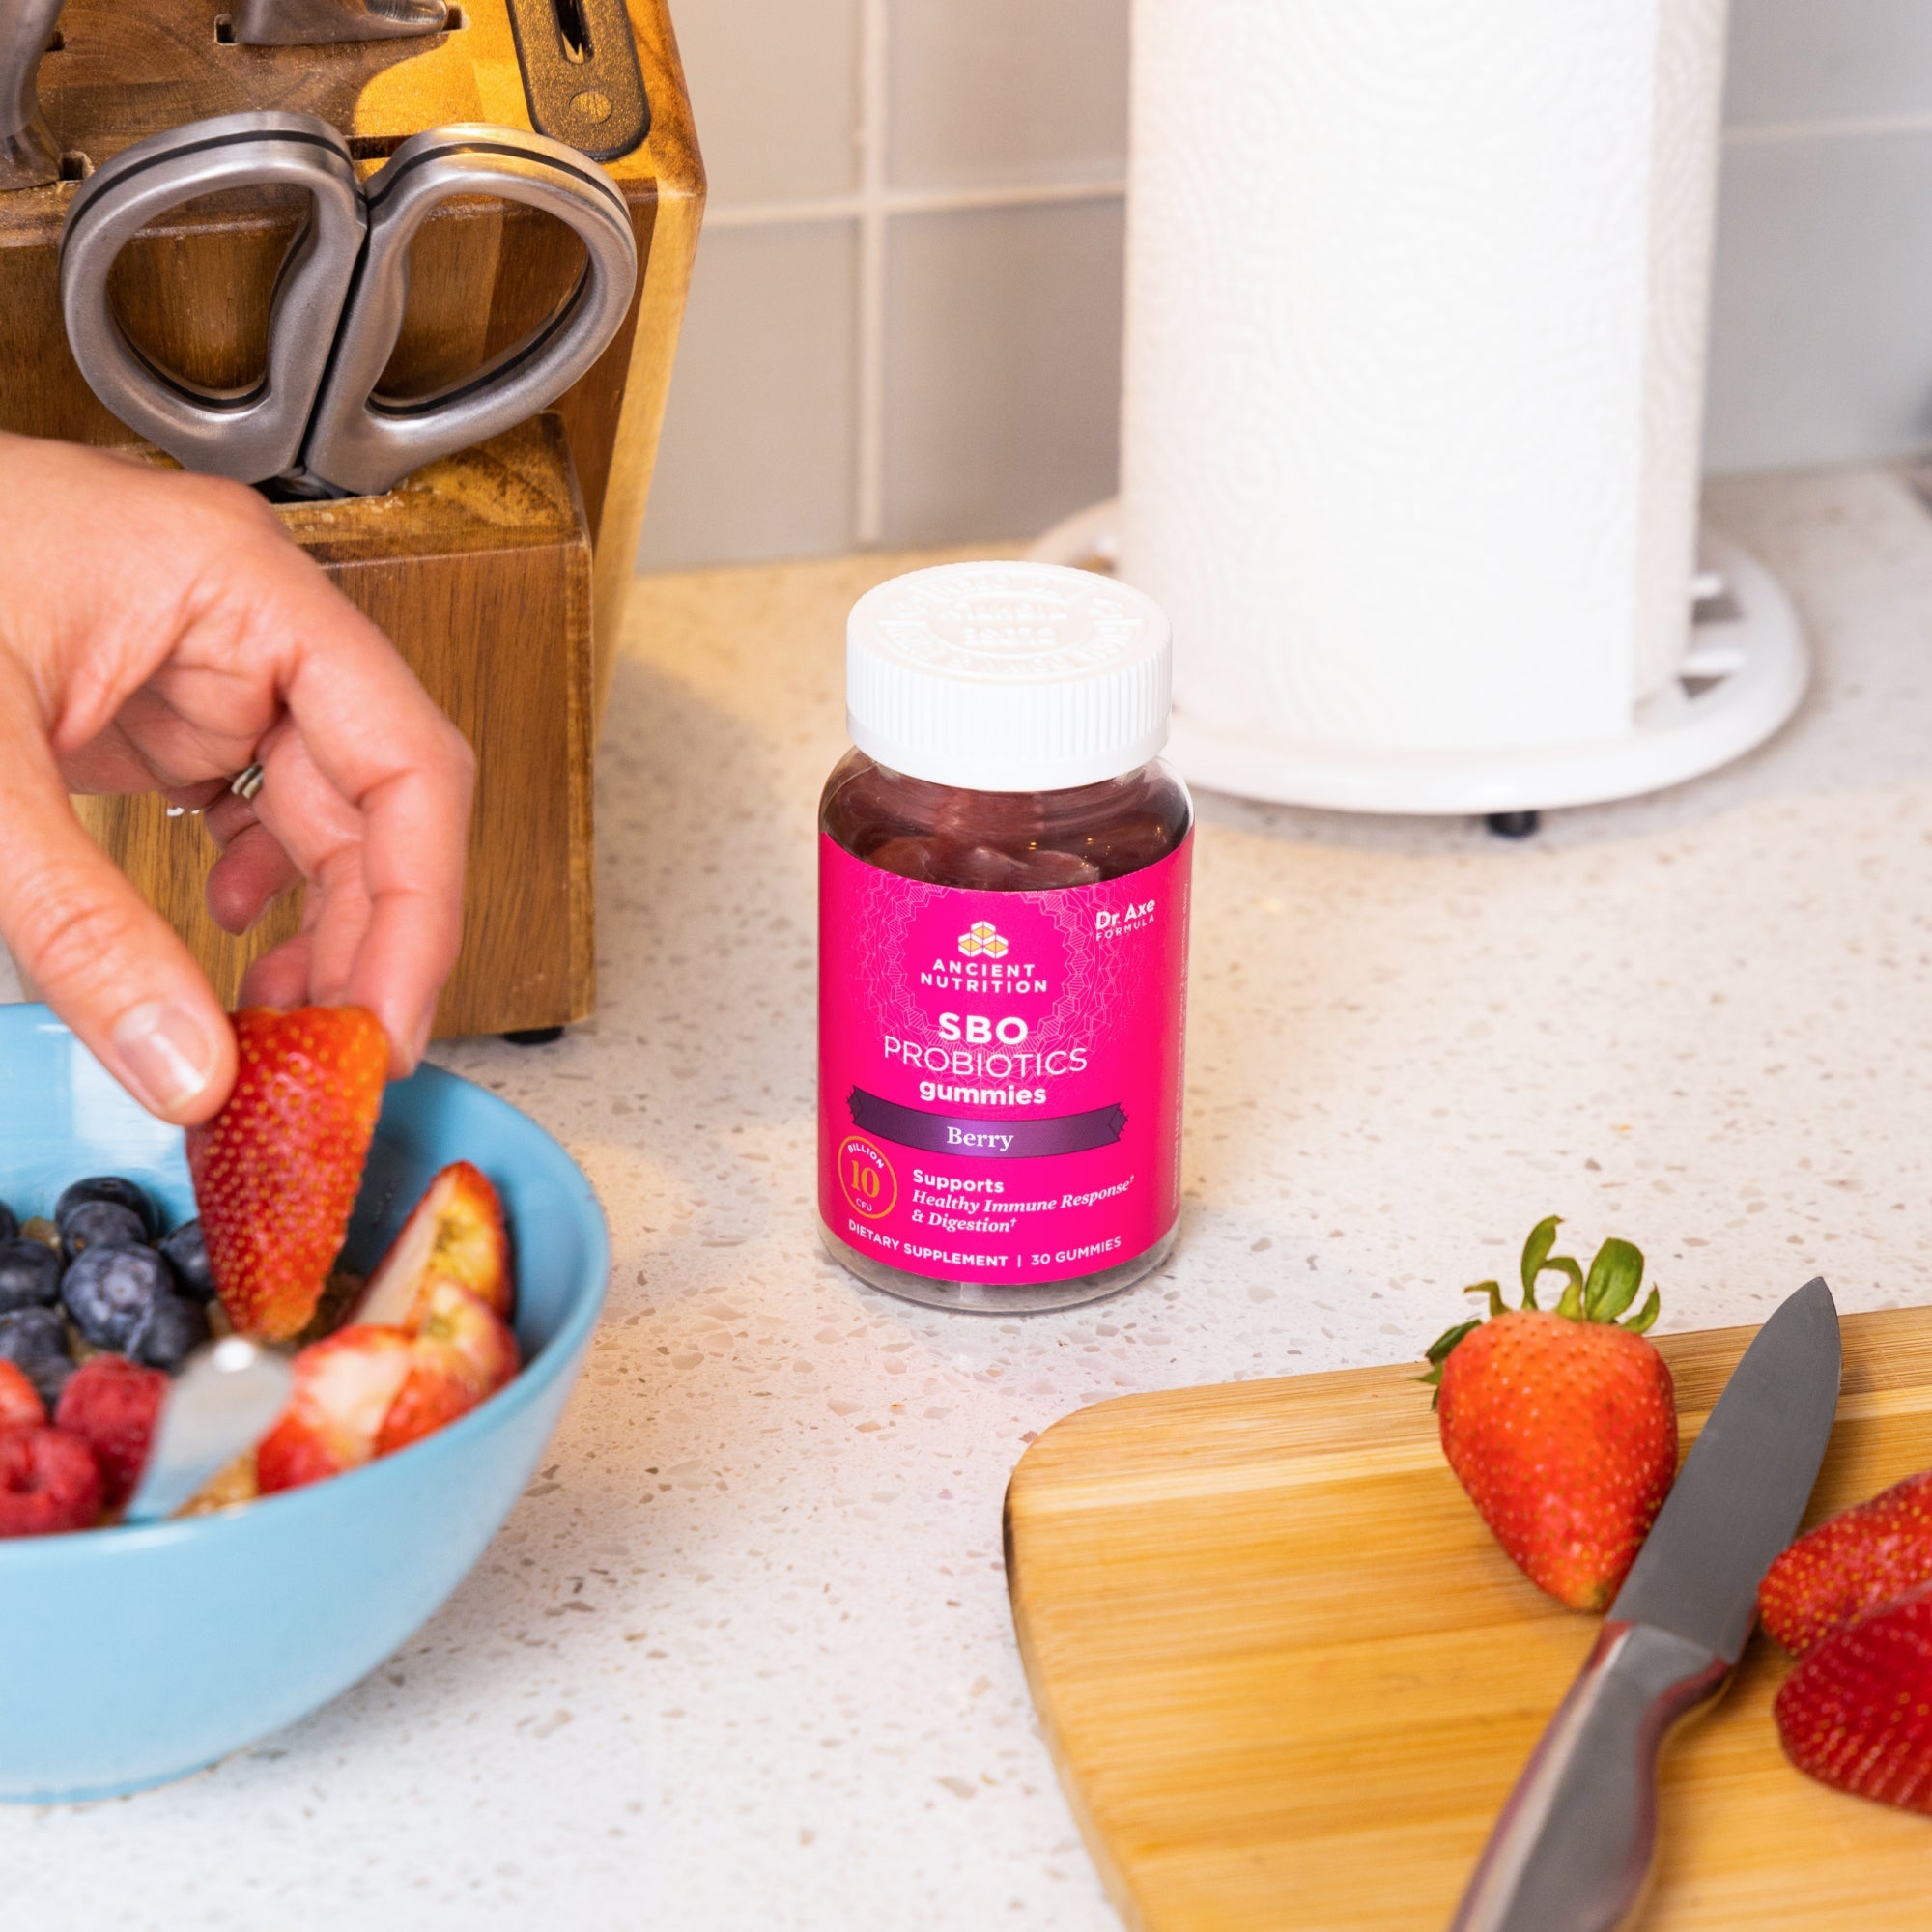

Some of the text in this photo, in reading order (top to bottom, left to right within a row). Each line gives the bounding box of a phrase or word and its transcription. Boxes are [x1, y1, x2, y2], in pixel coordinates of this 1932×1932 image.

[1094, 899, 1155, 930] Dr. Axe
[1095, 916, 1155, 941] FORMULA
[932, 958, 1035, 978] ANCIENT
[921, 972, 1047, 994] NUTRITION
[938, 1012, 1029, 1045] SBO
[885, 1035, 1087, 1078] PROBIOTICS
[919, 1081, 1046, 1105] gummies
[947, 1126, 1014, 1152] Berry
[847, 1143, 884, 1169] BILLION
[851, 1159, 880, 1198] 10
[913, 1169, 1005, 1193] Supports
[855, 1198, 873, 1212] CFU
[912, 1189, 980, 1215] Healthy
[983, 1199, 1057, 1213] Immune
[911, 1209, 924, 1223] &
[848, 1219, 900, 1250] DIETARY
[903, 1242, 1009, 1267] SUPPLEMENT
[1031, 1253, 1051, 1265] 30
[1055, 1236, 1122, 1263] GUMMIES
